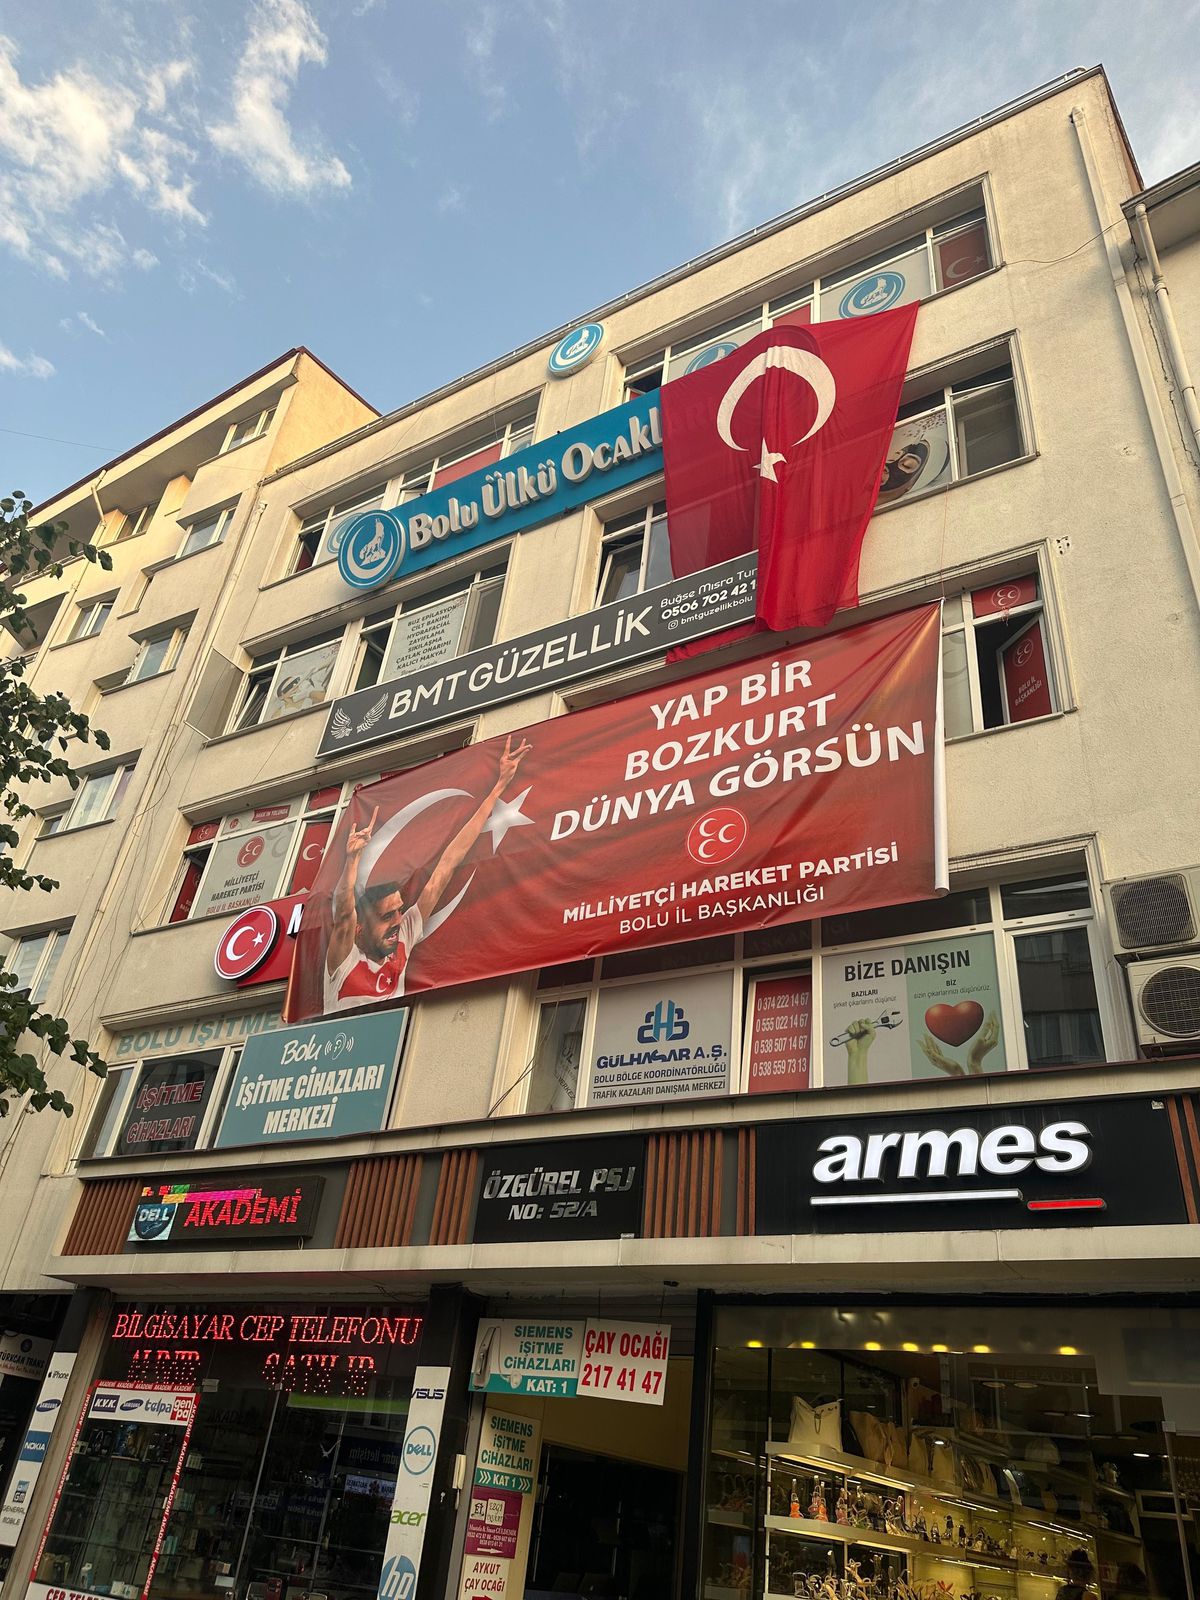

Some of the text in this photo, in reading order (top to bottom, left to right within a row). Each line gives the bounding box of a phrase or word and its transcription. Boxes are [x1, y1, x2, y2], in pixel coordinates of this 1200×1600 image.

[409, 407, 664, 550] Bolu Ülkü Ocakl
[660, 590, 695, 608] Buğse
[736, 568, 758, 580] Tur
[661, 579, 756, 620] 0506 702 42 1
[681, 595, 753, 624] bmtguzellikbolu
[407, 618, 421, 626] BUZ
[388, 606, 653, 720] BMT GÜZELLİK
[650, 659, 813, 730] YAP BİR
[624, 693, 836, 782] BOZKURT
[550, 720, 925, 841] DÜNYA GÖRSÜN
[224, 870, 260, 888] MİLLİYETÇİ
[562, 842, 899, 924] MİLLİYETÇİ HAREKET PARTİSİ
[211, 880, 265, 901] HAREKET PARTİSİ
[619, 885, 825, 935] BOLU İL BAŞKANLIĞI
[844, 949, 970, 982] BİZE DANIŞIN
[851, 989, 878, 998] BAZILARI
[945, 979, 957, 987] BİZ
[757, 998, 762, 1011] 0
[763, 996, 776, 1010] 374
[776, 994, 789, 1008] 222
[791, 993, 799, 1007] 14
[116, 1010, 281, 1056] BOLU İŞİTME
[756, 1013, 809, 1033] 0 555 022 14 67
[279, 1034, 322, 1065] Bolu
[693, 1044, 727, 1061] A.Ş.
[754, 1035, 808, 1054] 0 538 507 14 67
[594, 1062, 727, 1084] BOLU BÖLGE KOORDİNATÖRLÜĞÜ
[752, 1057, 807, 1077] 0 538 559 73 13
[136, 1077, 205, 1112] İŞİTME
[235, 1064, 385, 1110] İŞİTME CİHAZLARI
[592, 1079, 726, 1099] TRAFİK KAZALARI DANIŞMA MERKEZİ
[262, 1096, 338, 1135] MERKEZİ
[126, 1115, 196, 1143] CİHAZLARI
[812, 1120, 1093, 1184] armes
[483, 1167, 582, 1199] ÖZGÜREL
[183, 1188, 302, 1228] AKADEMİ
[508, 1200, 598, 1221] NO: 52/A
[112, 1310, 423, 1345] BİLGİSAYAR CEP TELEFONU
[514, 1325, 573, 1339] SIEMENS
[585, 1329, 668, 1360] ÇAY OCAĞI
[526, 1378, 568, 1394] KAT: 1
[581, 1363, 663, 1395] 217 41 47
[174, 1399, 191, 1411] gen
[411, 1388, 444, 1400] ASUS
[176, 1409, 190, 1418] pa
[490, 1415, 533, 1437] SIEMENS
[24, 1441, 45, 1451] NOKIA
[406, 1443, 432, 1457] DELL
[493, 1473, 516, 1488] KAT 1
[390, 1509, 426, 1527] acer
[381, 1554, 415, 1600] hp
[472, 1561, 501, 1575] AYKUT
[464, 1577, 506, 1592] ÇAY OCAĞI
